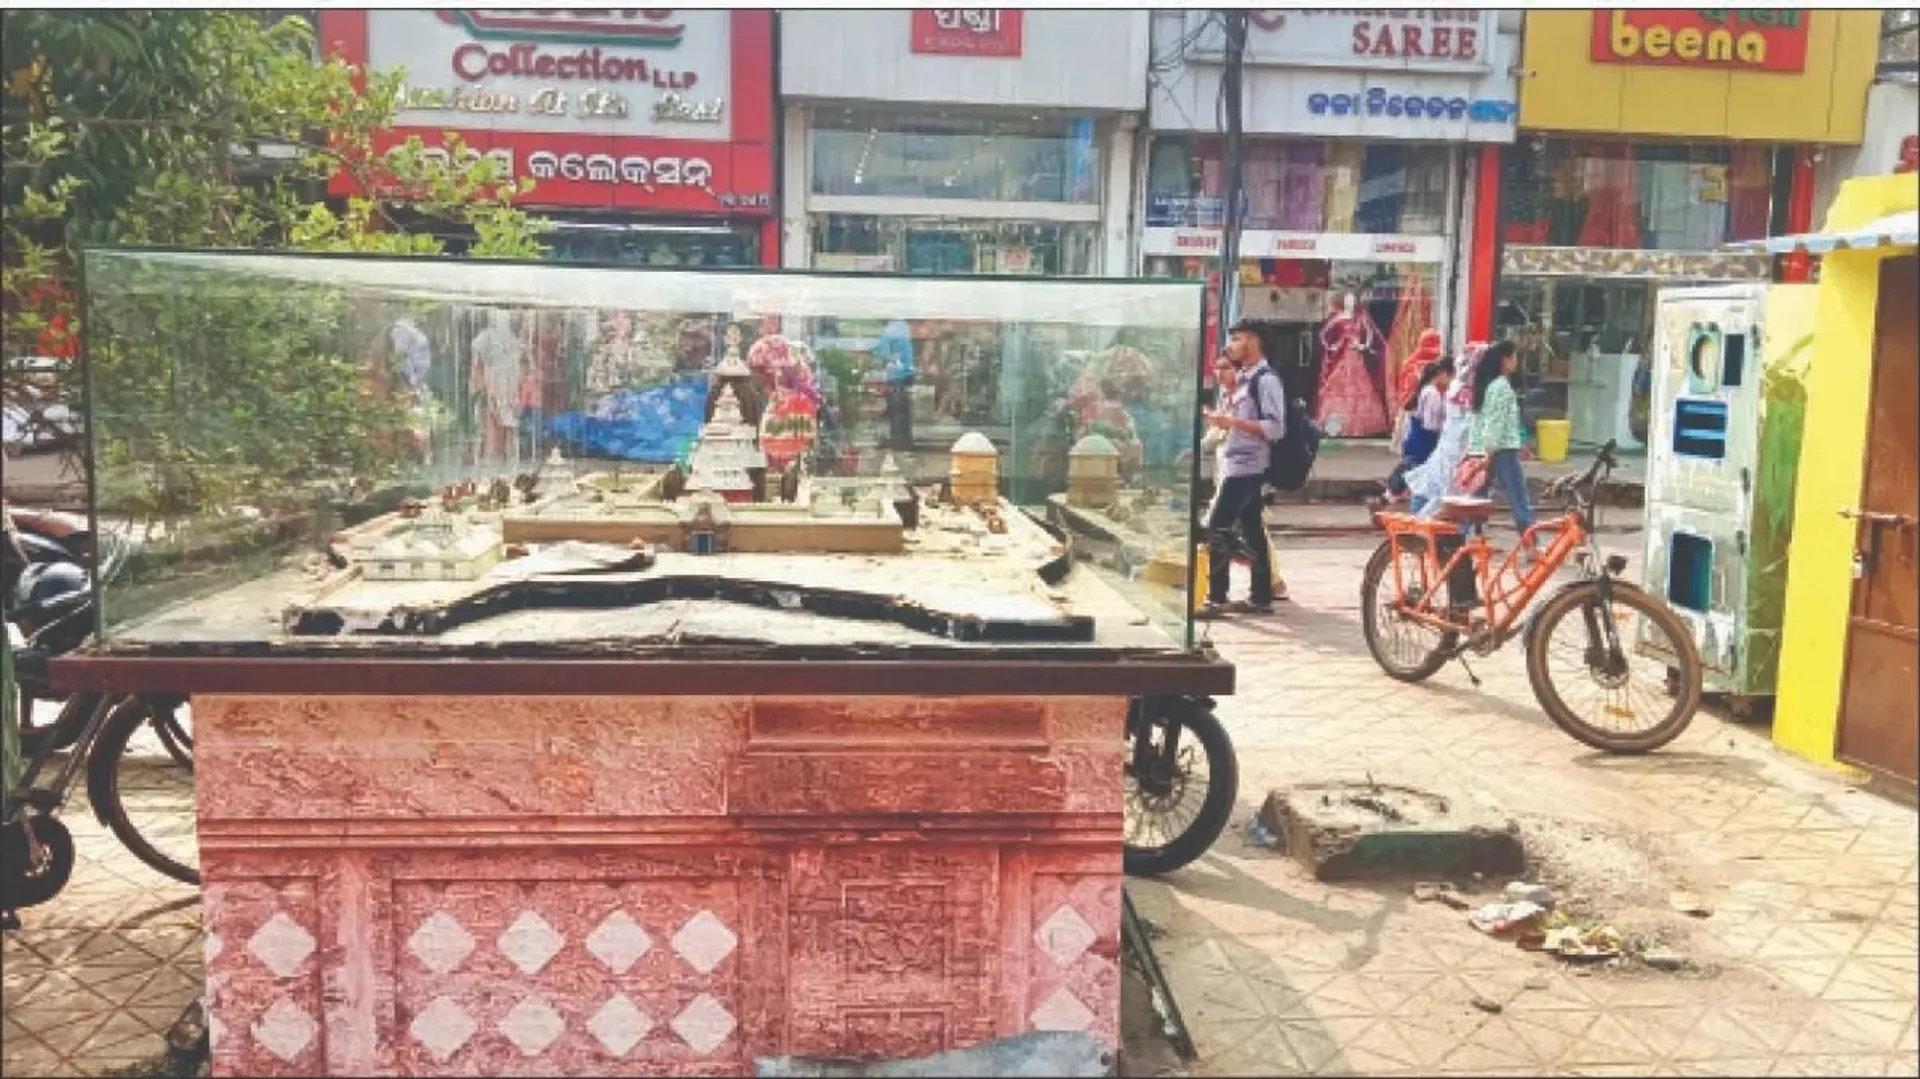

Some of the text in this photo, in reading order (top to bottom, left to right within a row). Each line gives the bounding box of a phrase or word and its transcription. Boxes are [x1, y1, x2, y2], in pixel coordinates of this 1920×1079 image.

[1352, 21, 1477, 60] SAREE
[1611, 9, 1766, 63] beena
[451, 42, 698, 89] Collection LLP
